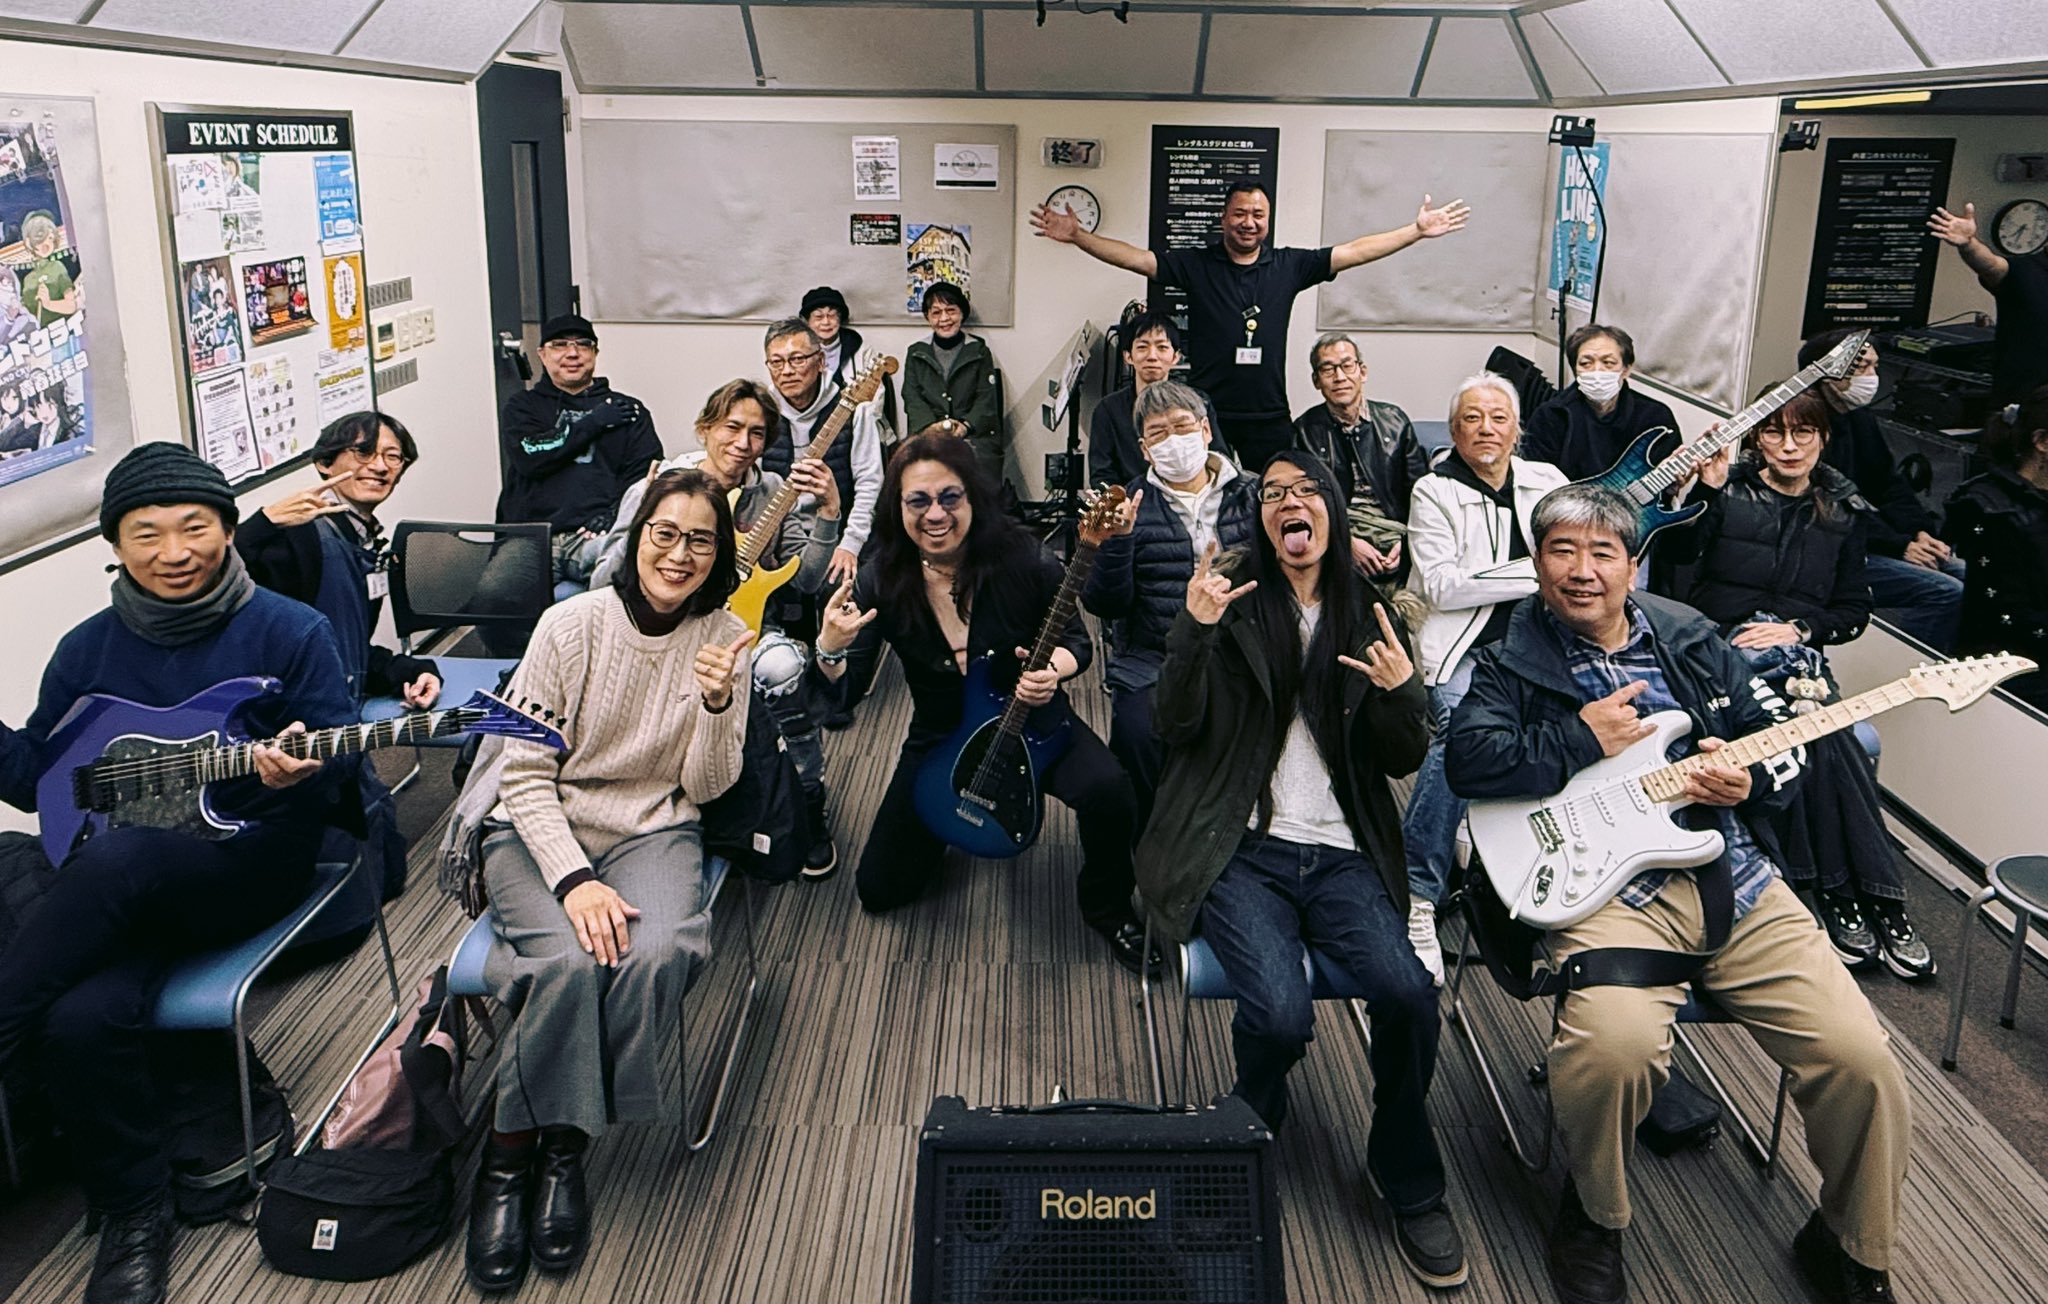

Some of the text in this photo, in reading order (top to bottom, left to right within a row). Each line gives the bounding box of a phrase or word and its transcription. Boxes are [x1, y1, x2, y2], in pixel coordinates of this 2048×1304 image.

[188, 122, 338, 145] EVENT SCHEDULE
[1051, 140, 1096, 164] 終了
[1564, 153, 1600, 190] HOT
[1561, 188, 1598, 225] LINE
[1041, 1188, 1156, 1220] Roland
